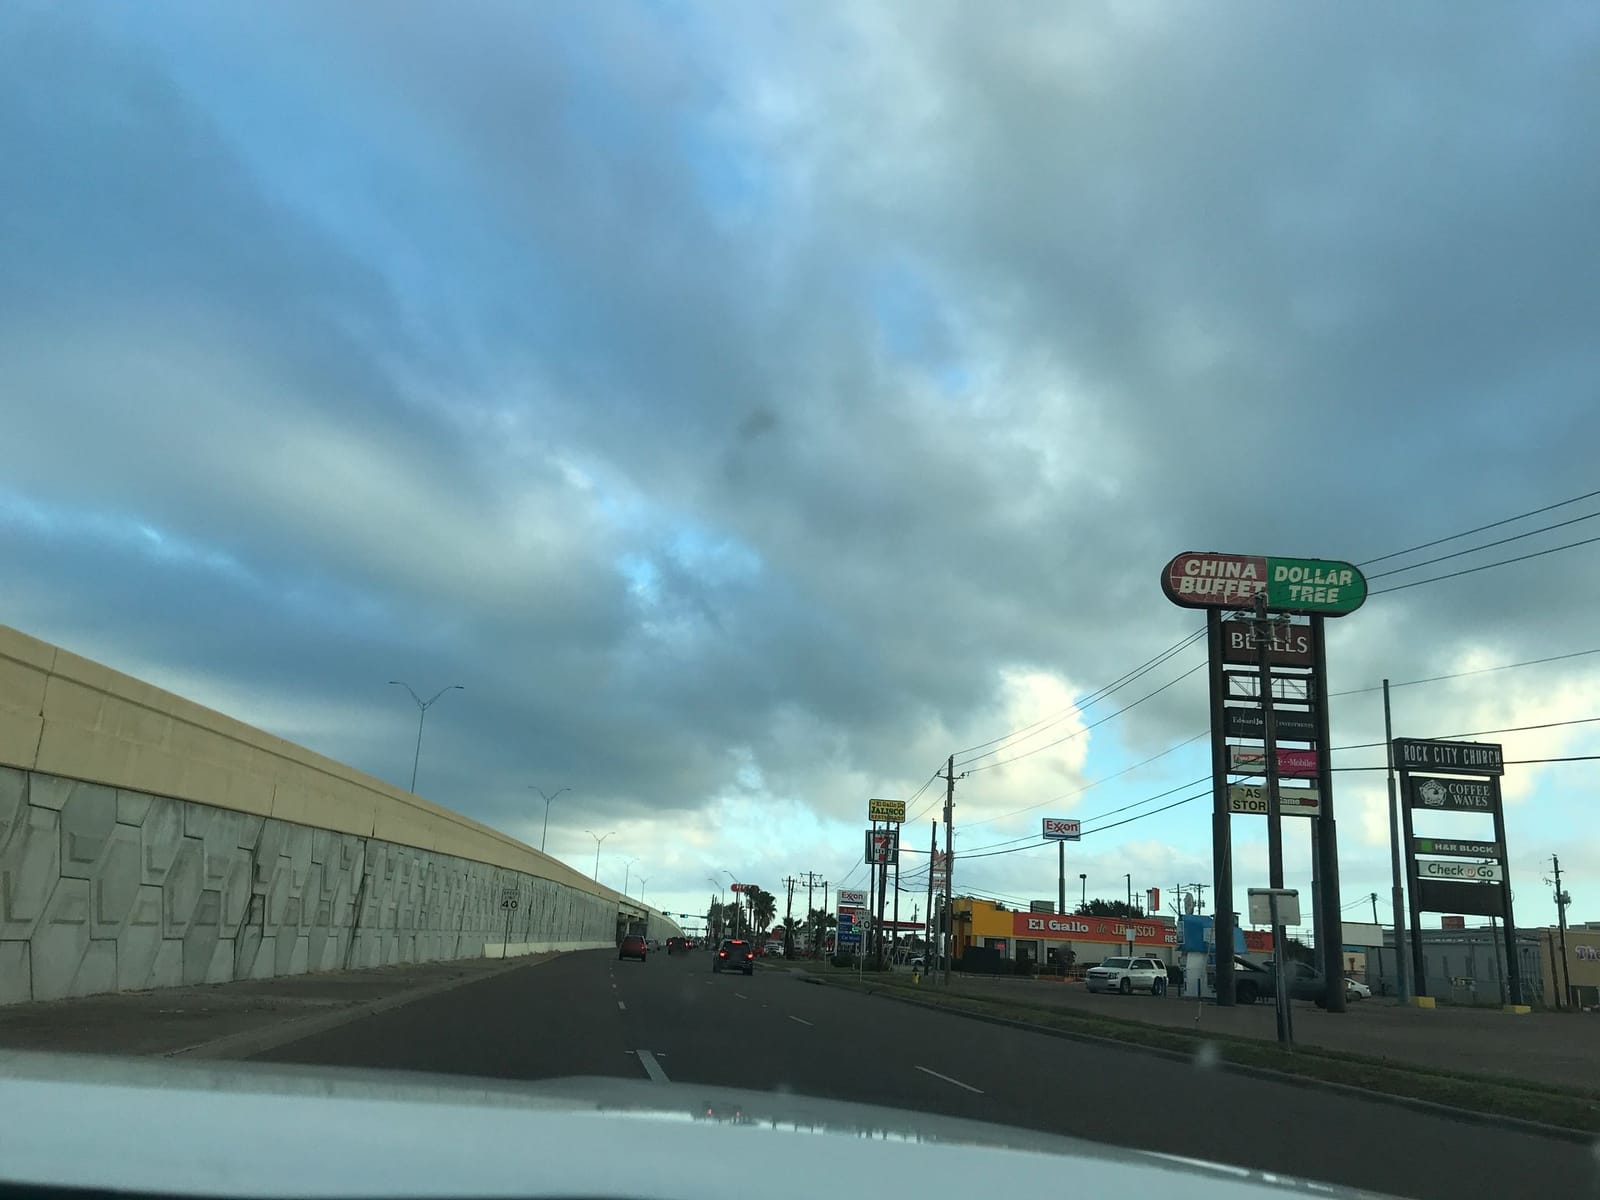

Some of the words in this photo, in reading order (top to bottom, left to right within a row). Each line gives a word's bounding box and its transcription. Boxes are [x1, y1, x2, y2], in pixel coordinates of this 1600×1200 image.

[1184, 559, 1258, 580] CHINA
[1274, 566, 1353, 587] DOLLAR
[1179, 577, 1268, 598] BUFFET
[1289, 584, 1340, 603] TREE
[1403, 744, 1429, 763] ROCK
[1433, 747, 1458, 765] CITY
[1462, 749, 1502, 768] CHURCH
[1448, 783, 1490, 797] COFFEE
[1232, 799, 1267, 812] STOR
[1453, 794, 1488, 807] WAVES
[871, 805, 904, 816] JALISCO
[1046, 820, 1078, 834] Exxon
[1434, 843, 1457, 853] H&R
[1459, 844, 1495, 854] BLOCK
[1427, 863, 1464, 877] Check
[1477, 866, 1494, 878] Go
[841, 891, 864, 901] Exxon
[501, 900, 519, 909] 40
[857, 920, 870, 929] 40
[1028, 918, 1045, 931] El
[1048, 919, 1089, 934] Gallo
